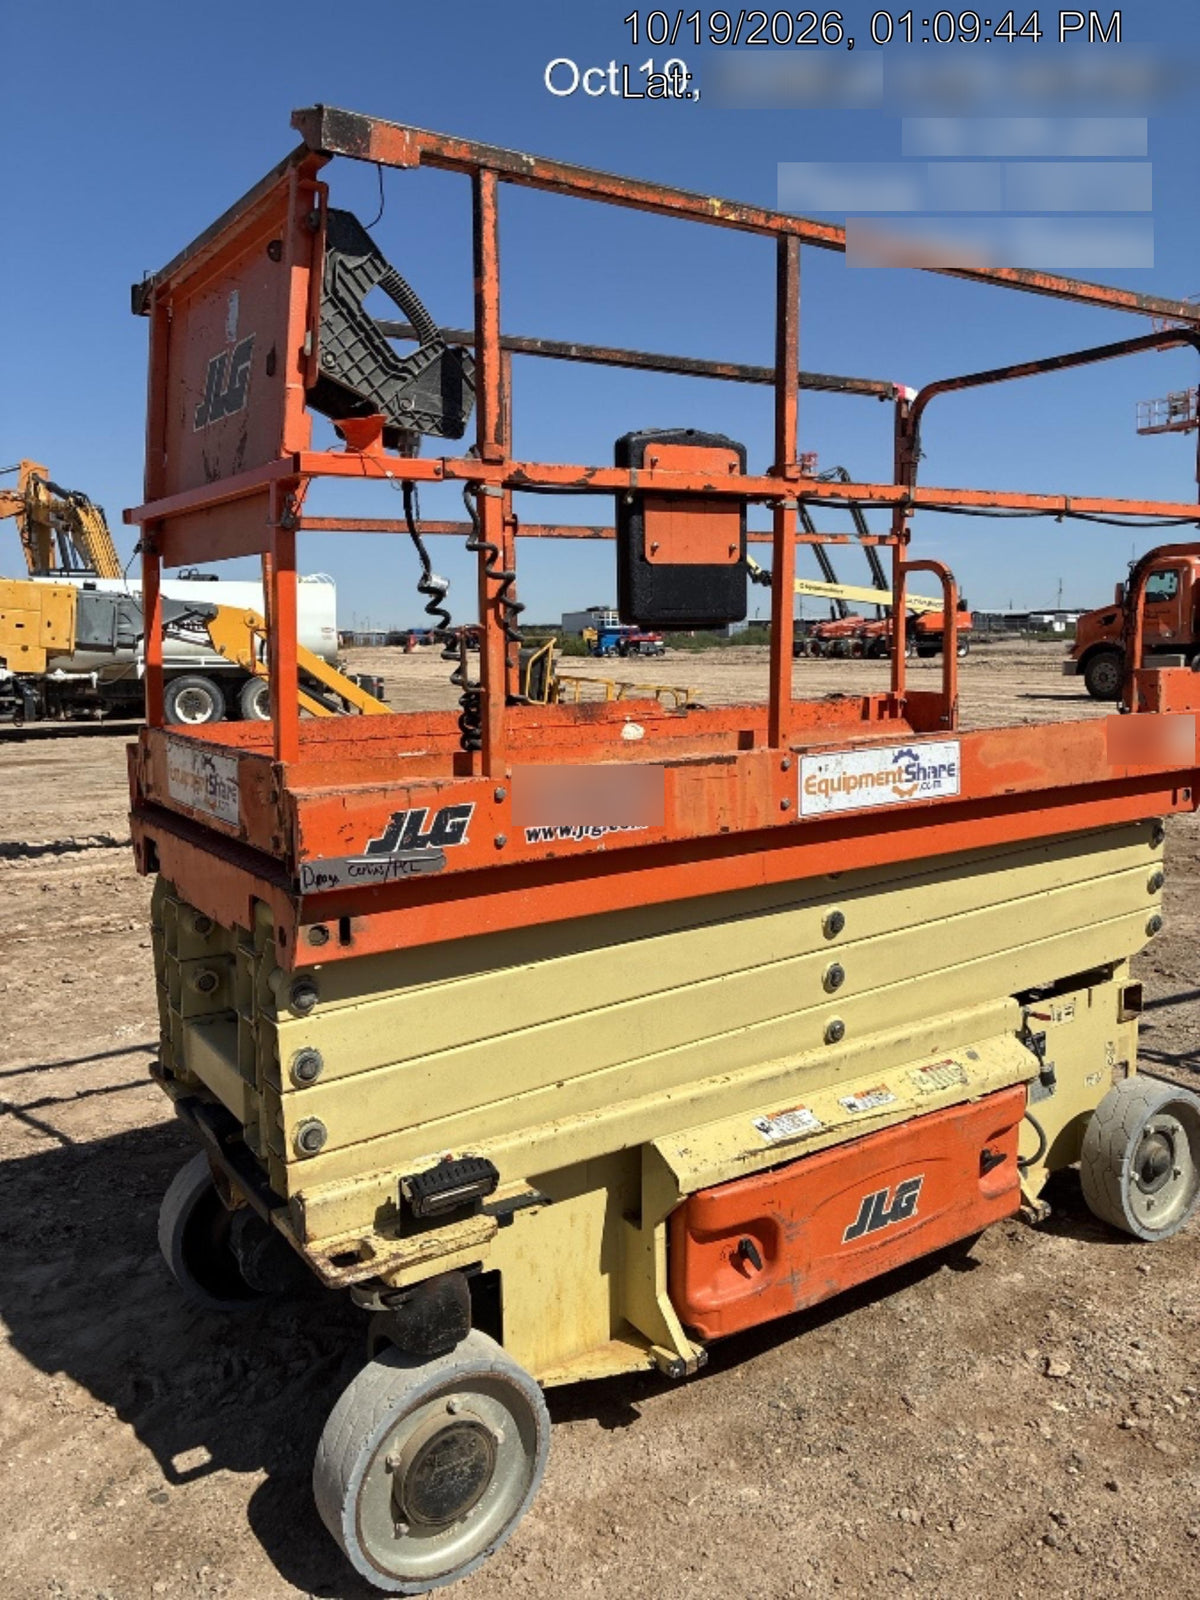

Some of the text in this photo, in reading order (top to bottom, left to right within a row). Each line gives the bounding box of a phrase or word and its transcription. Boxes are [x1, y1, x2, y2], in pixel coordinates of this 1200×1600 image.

[194, 333, 256, 432] JLG
[804, 763, 956, 799] EquipmentShare
[364, 802, 476, 855] JLG
[841, 1173, 925, 1245] JLG
